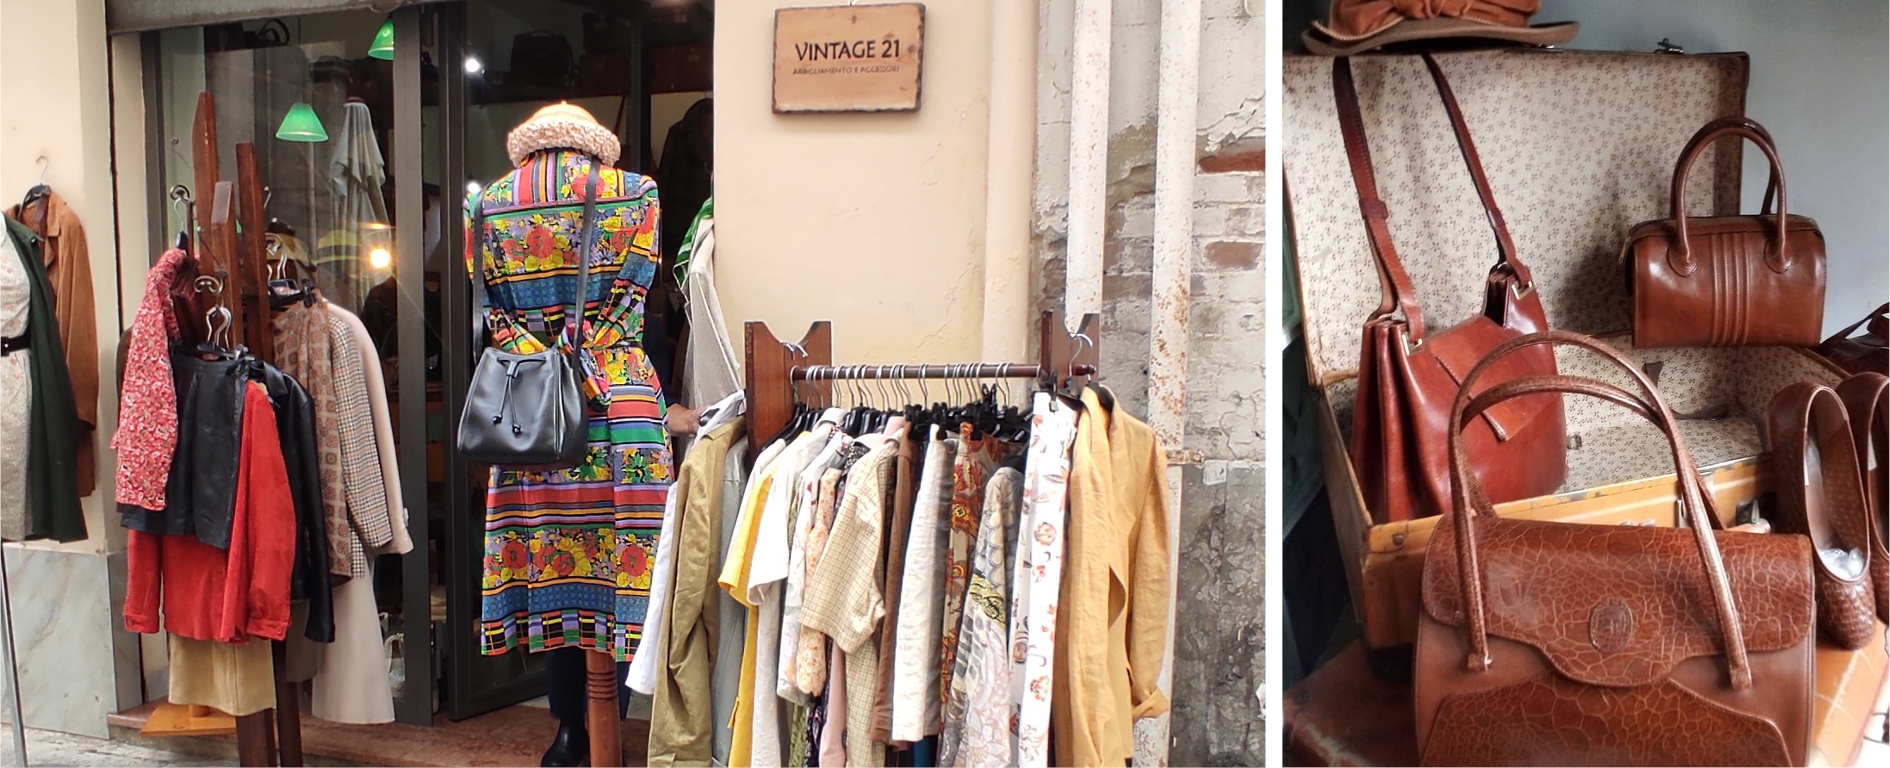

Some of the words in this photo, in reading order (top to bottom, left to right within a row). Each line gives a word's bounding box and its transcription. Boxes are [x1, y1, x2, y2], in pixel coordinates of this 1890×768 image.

[795, 40, 876, 61] VINTAGE
[881, 39, 900, 58] 21
[792, 66, 853, 75] ABBIGLIAMENTO
[854, 65, 859, 74] E
[860, 65, 900, 74] ACCESSORI
